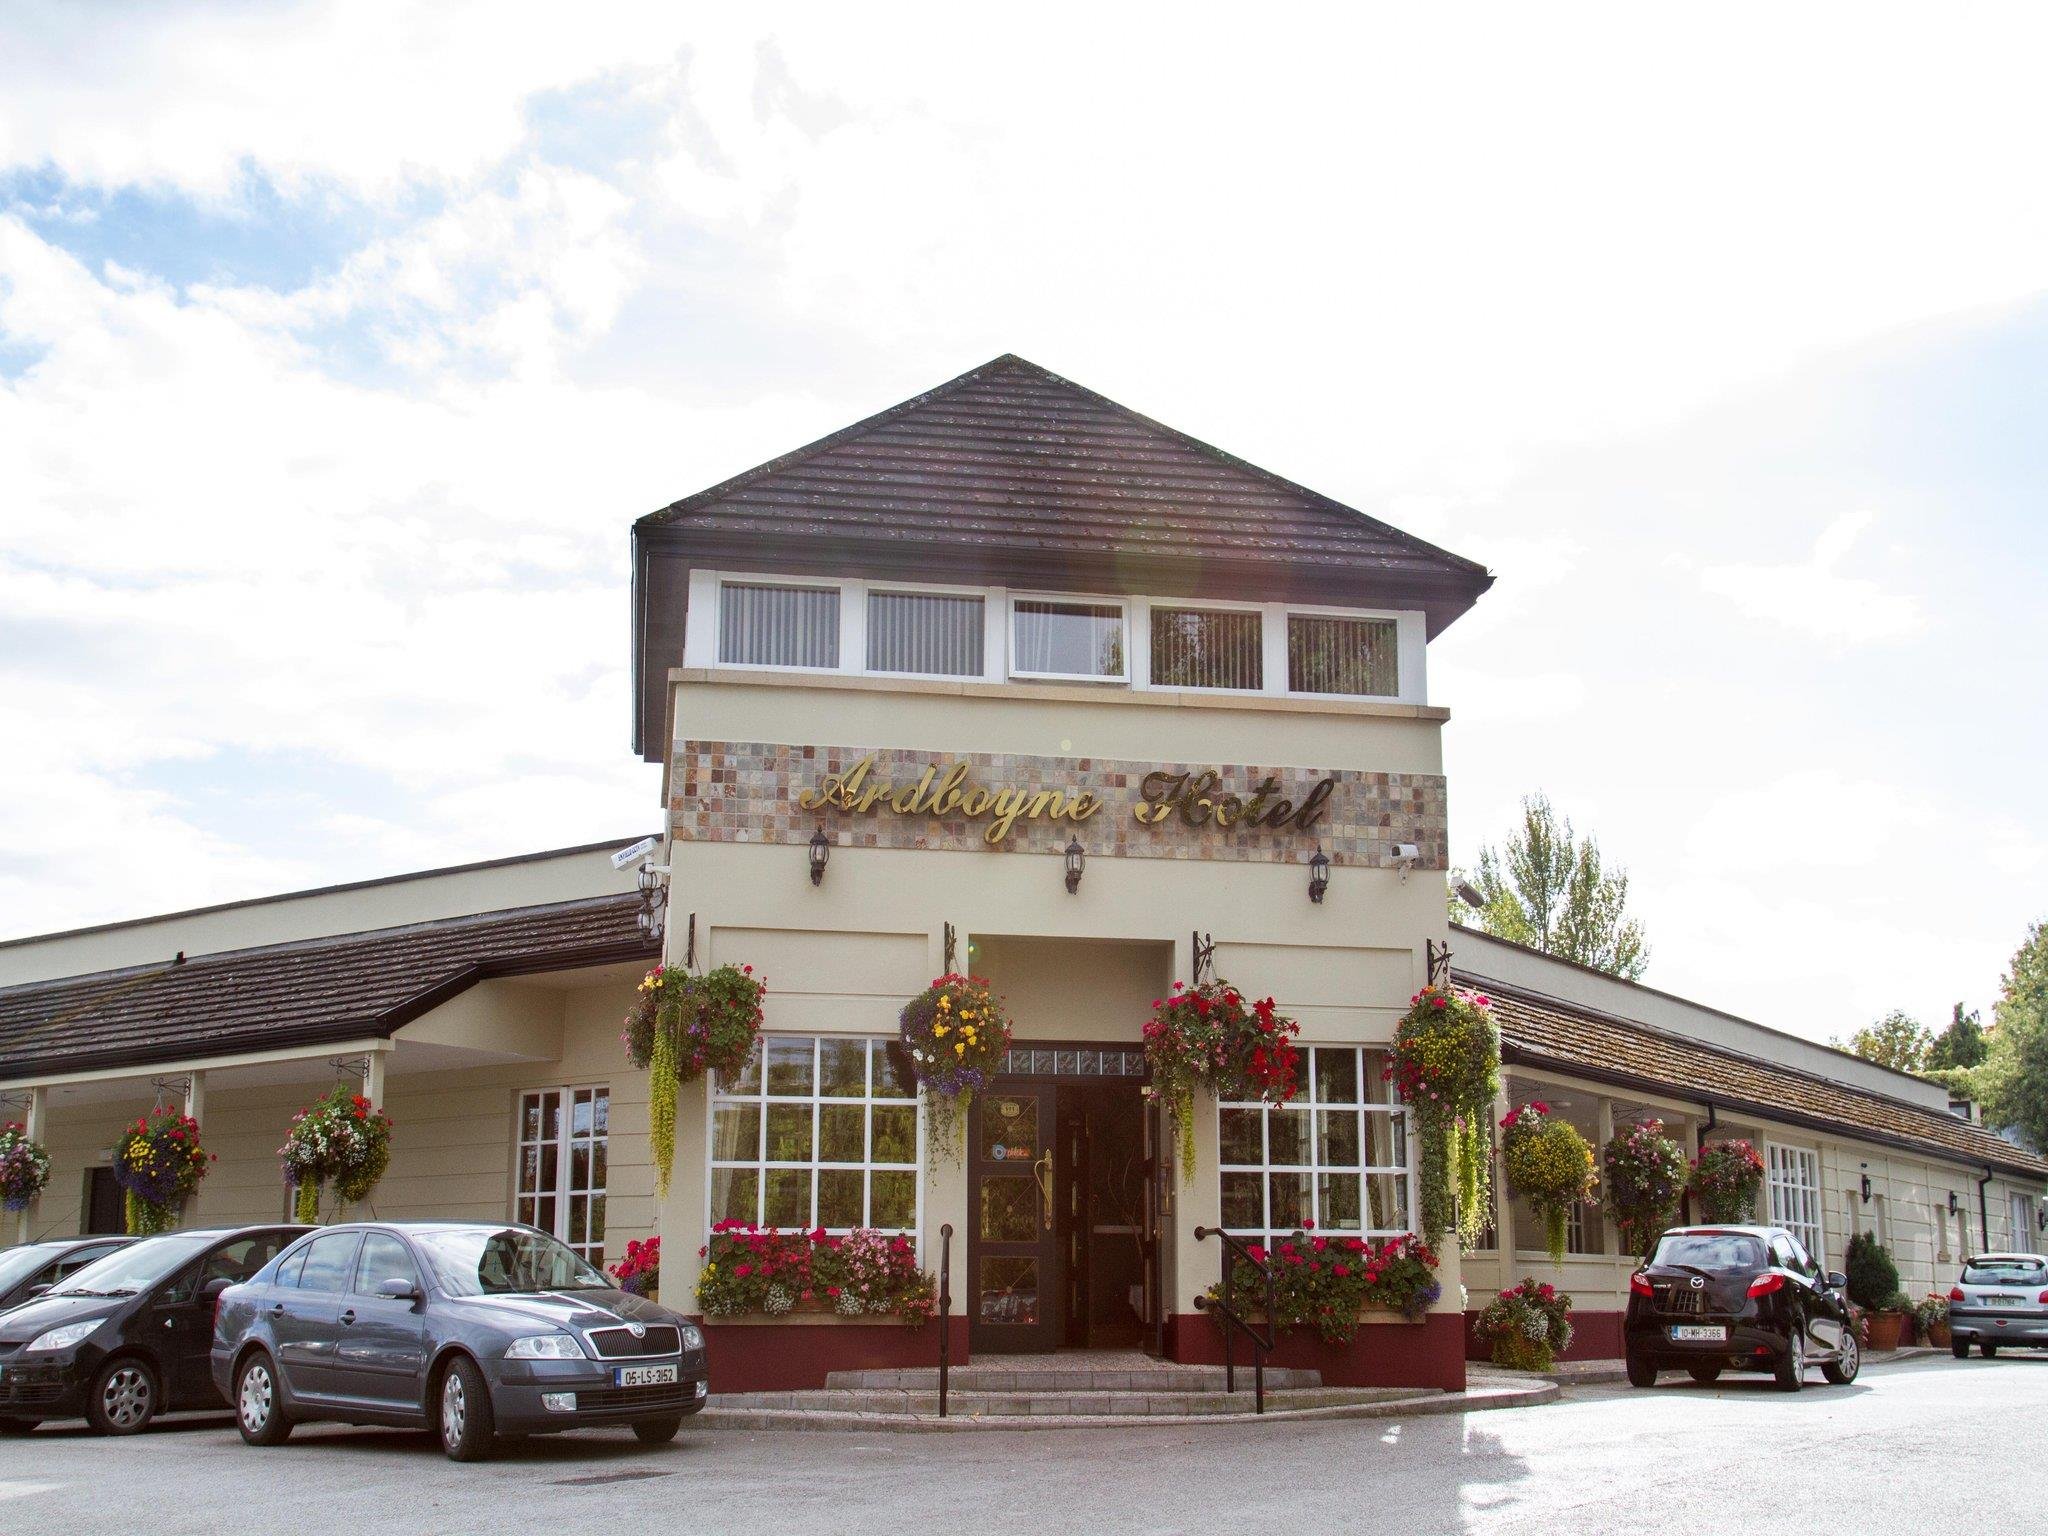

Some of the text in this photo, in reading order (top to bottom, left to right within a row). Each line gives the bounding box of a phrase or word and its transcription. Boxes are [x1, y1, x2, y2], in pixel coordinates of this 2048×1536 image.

[800, 752, 1335, 845] Ardboyne Hotel
[625, 1368, 673, 1385] 05-LS-3152
